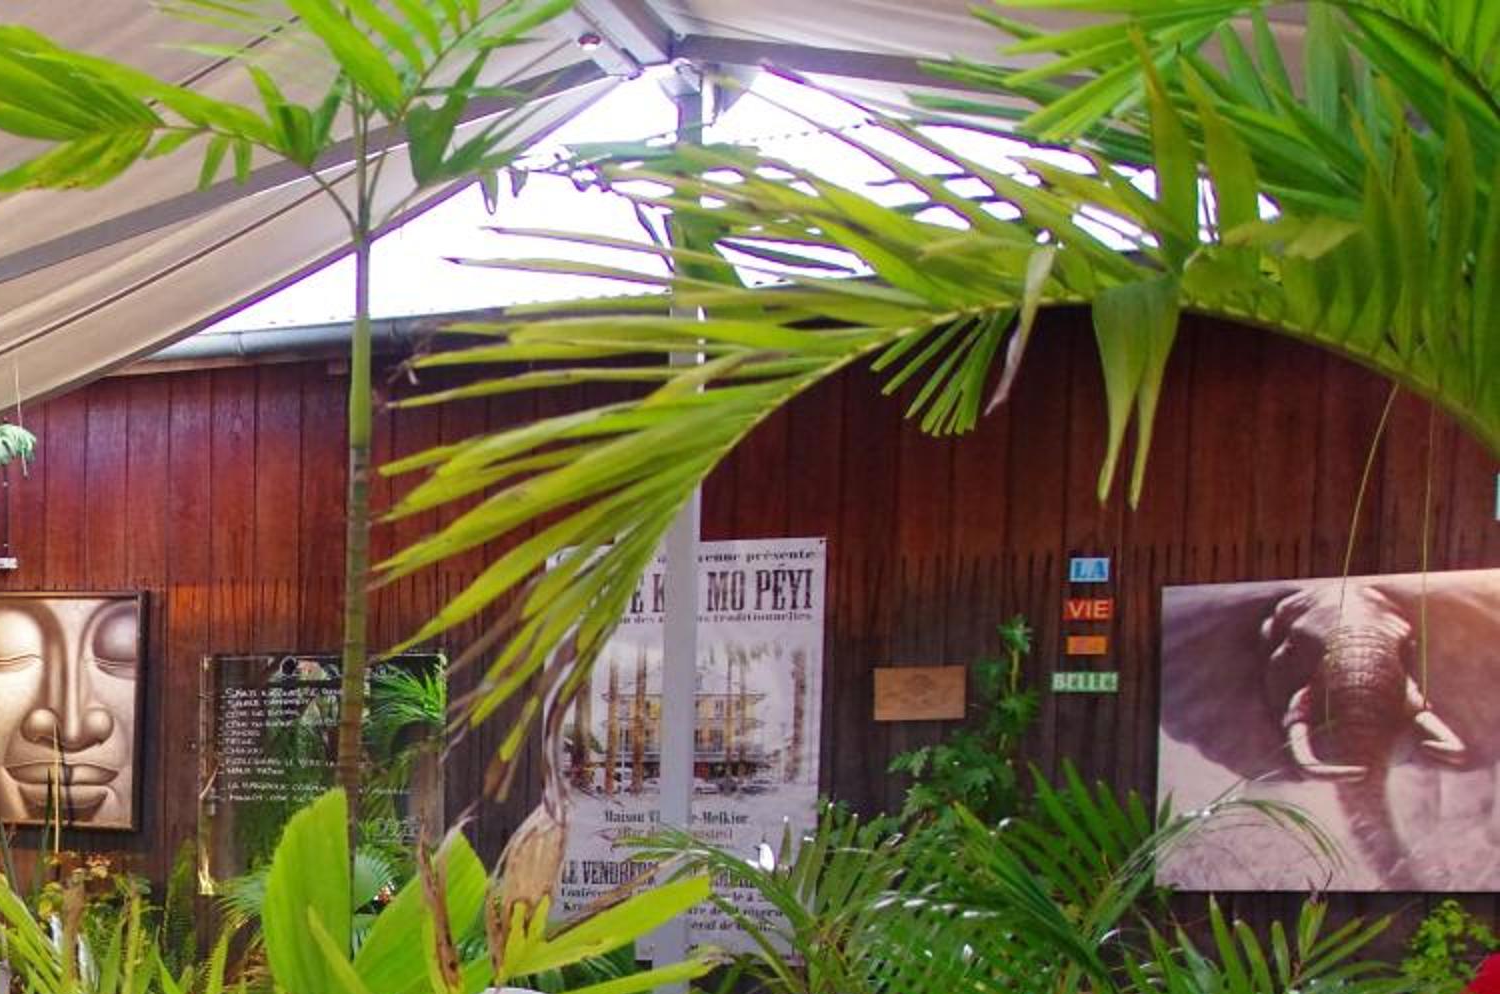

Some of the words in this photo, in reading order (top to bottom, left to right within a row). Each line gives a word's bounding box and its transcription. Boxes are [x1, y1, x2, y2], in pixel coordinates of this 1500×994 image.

[746, 550, 815, 564] présente
[1074, 561, 1107, 578] LA
[707, 570, 746, 612] MO
[754, 563, 814, 611] PÉYI
[713, 611, 813, 623] traditionnelles
[1068, 600, 1109, 619] VIE
[1052, 672, 1118, 692] BELLE!
